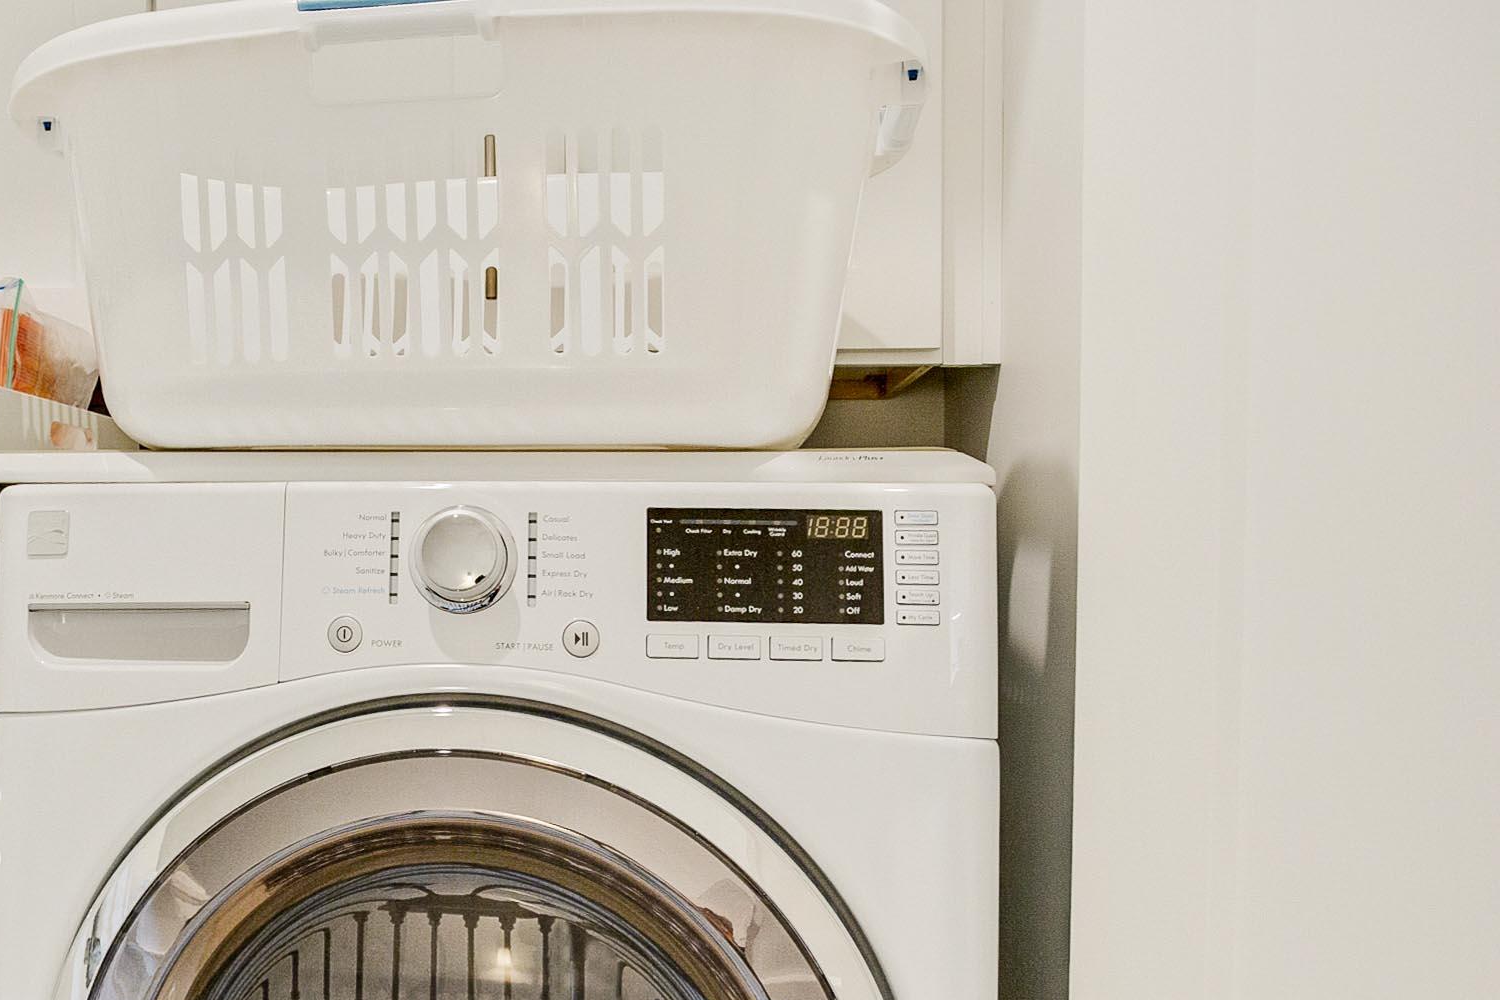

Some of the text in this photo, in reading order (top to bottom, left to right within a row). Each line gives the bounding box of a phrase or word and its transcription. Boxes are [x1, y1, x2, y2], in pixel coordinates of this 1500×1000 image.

[543, 514, 571, 523] Casual
[807, 516, 868, 538] 18:88
[342, 532, 387, 540] Heavy Duty
[743, 528, 762, 536] Cooling
[542, 533, 578, 541] Delicates
[541, 551, 586, 560] Small Load
[663, 548, 681, 558] High
[723, 548, 758, 558] Extra Dry
[791, 549, 803, 558] 60
[844, 550, 875, 559] Connect
[355, 567, 386, 575] Sanitize
[791, 563, 803, 572] 50
[857, 565, 875, 573] Water
[542, 569, 587, 579] Express Dry
[663, 576, 694, 584] Medium
[723, 577, 752, 585] Normal
[791, 578, 804, 587] 40
[845, 578, 864, 586] Loud
[332, 586, 386, 595] Steam Refresh
[579, 590, 594, 599] Dry
[35, 592, 65, 600] Kenmore
[792, 592, 804, 601] 30
[846, 592, 862, 601] Soft
[663, 604, 679, 612] Low
[724, 604, 762, 614] Damp Dry
[792, 606, 804, 615] 20
[846, 606, 861, 615] Off
[371, 639, 403, 648] POWER
[495, 642, 554, 651] START PAUSE
[663, 641, 685, 651] Temp
[717, 642, 754, 652] Dry Level
[778, 643, 818, 654] Timed Dry
[846, 644, 872, 653] Chime
